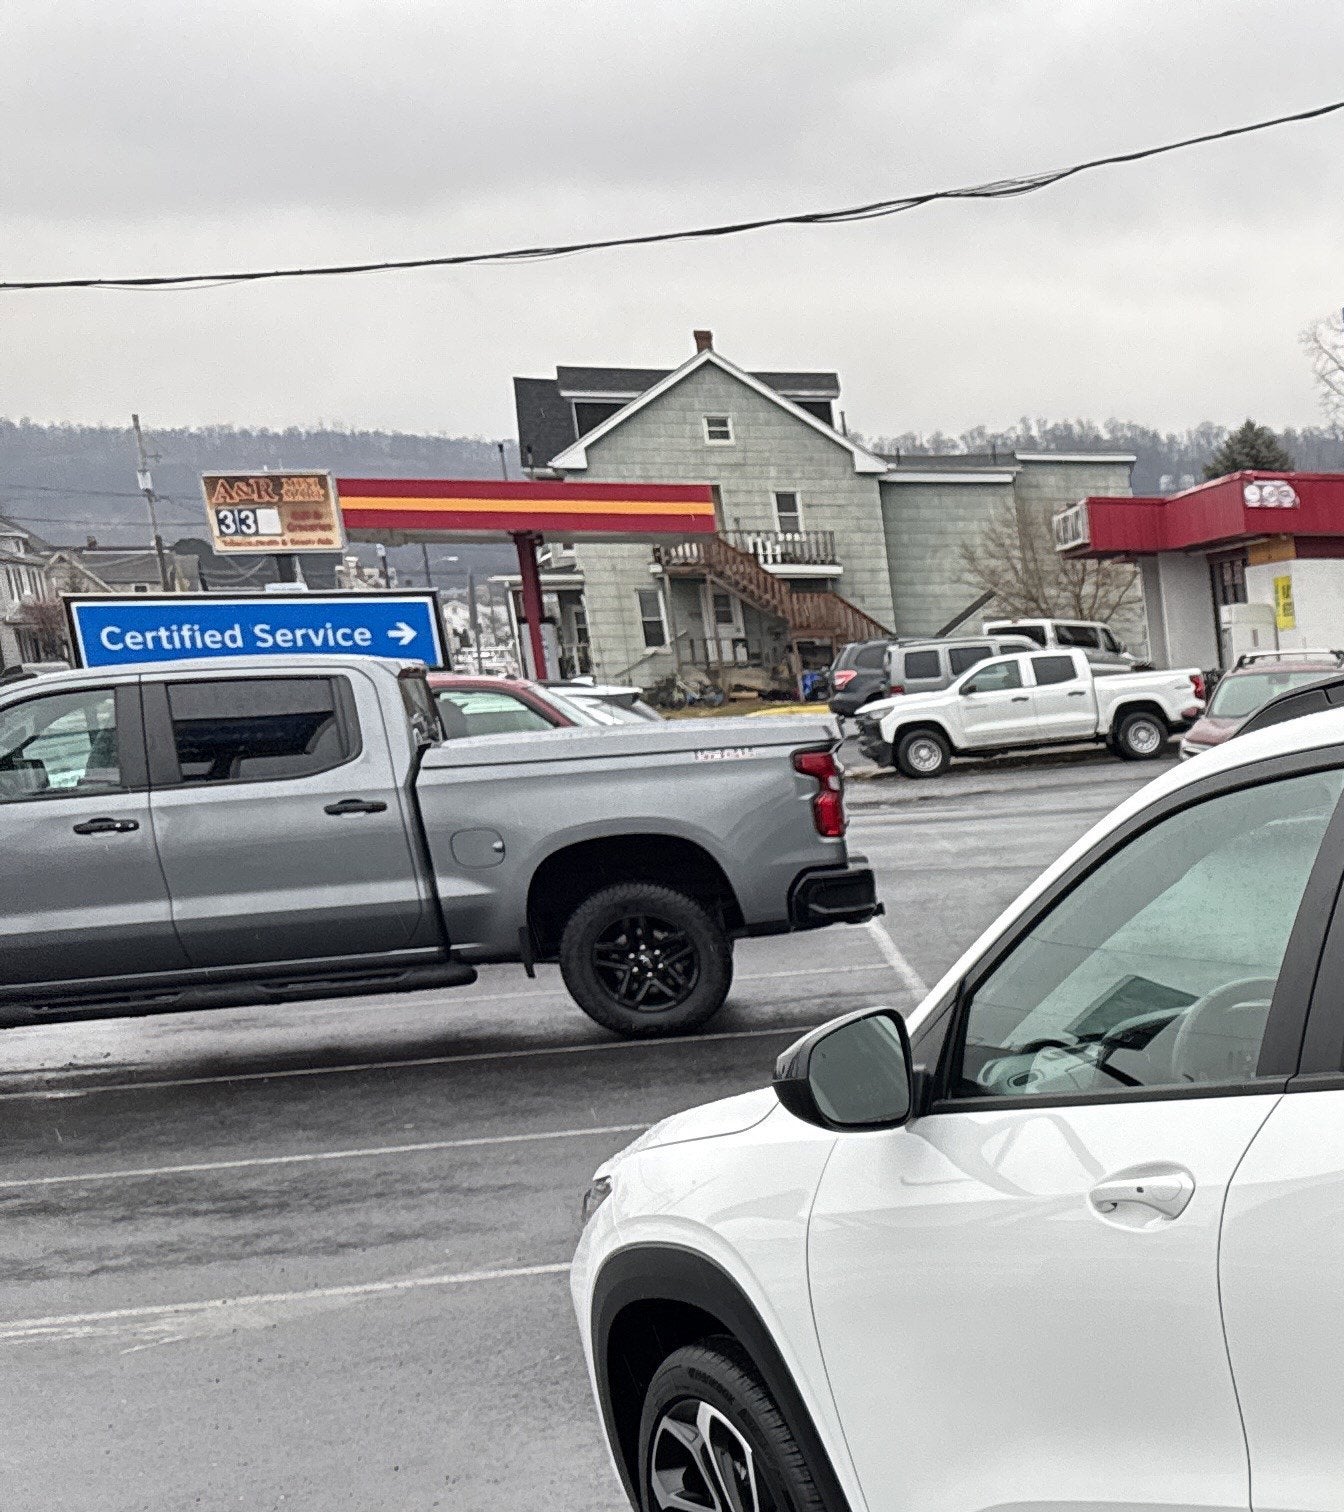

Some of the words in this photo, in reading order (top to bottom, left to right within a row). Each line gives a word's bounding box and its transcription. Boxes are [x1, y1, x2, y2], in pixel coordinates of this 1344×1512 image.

[212, 478, 279, 503] A&R
[100, 623, 243, 651] Certified
[252, 621, 372, 649] Service
